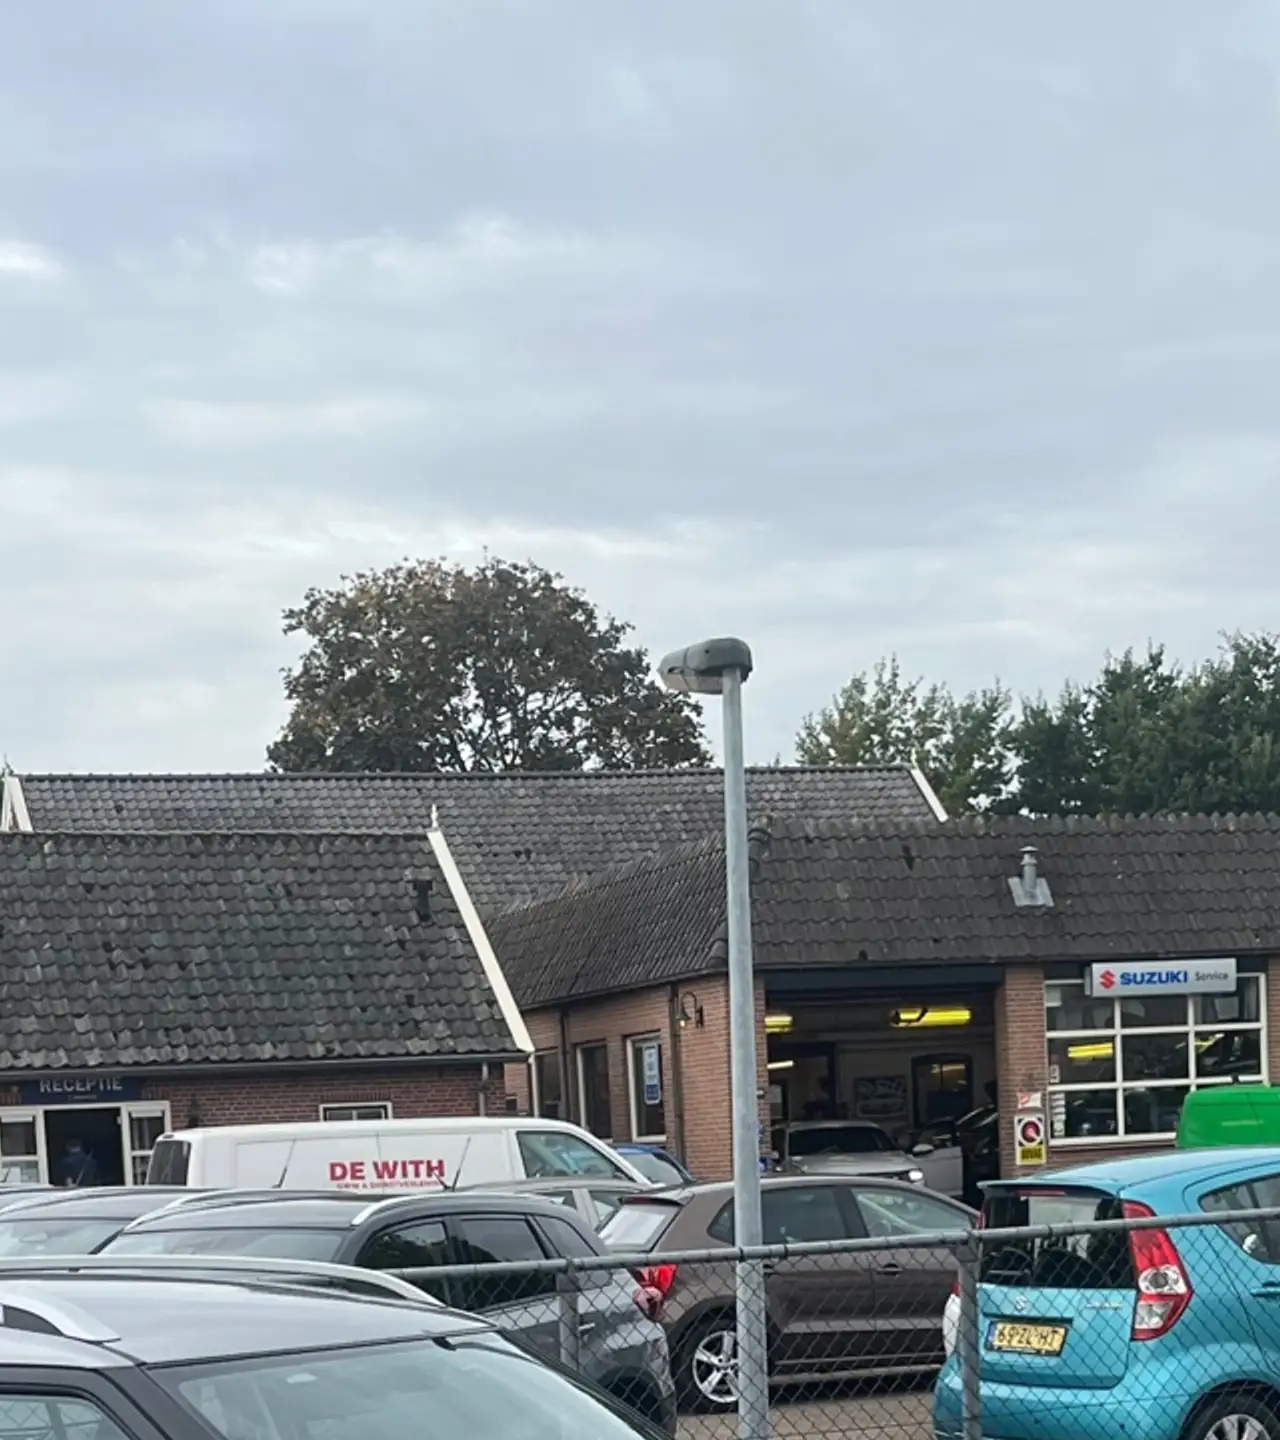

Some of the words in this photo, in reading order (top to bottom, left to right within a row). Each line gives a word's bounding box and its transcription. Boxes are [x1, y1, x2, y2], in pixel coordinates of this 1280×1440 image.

[1120, 970, 1188, 986] SUZUKI
[1194, 970, 1229, 982] Service
[39, 1077, 123, 1093] RECEPTIE
[329, 1161, 366, 1181] DE
[371, 1159, 445, 1179] WITH
